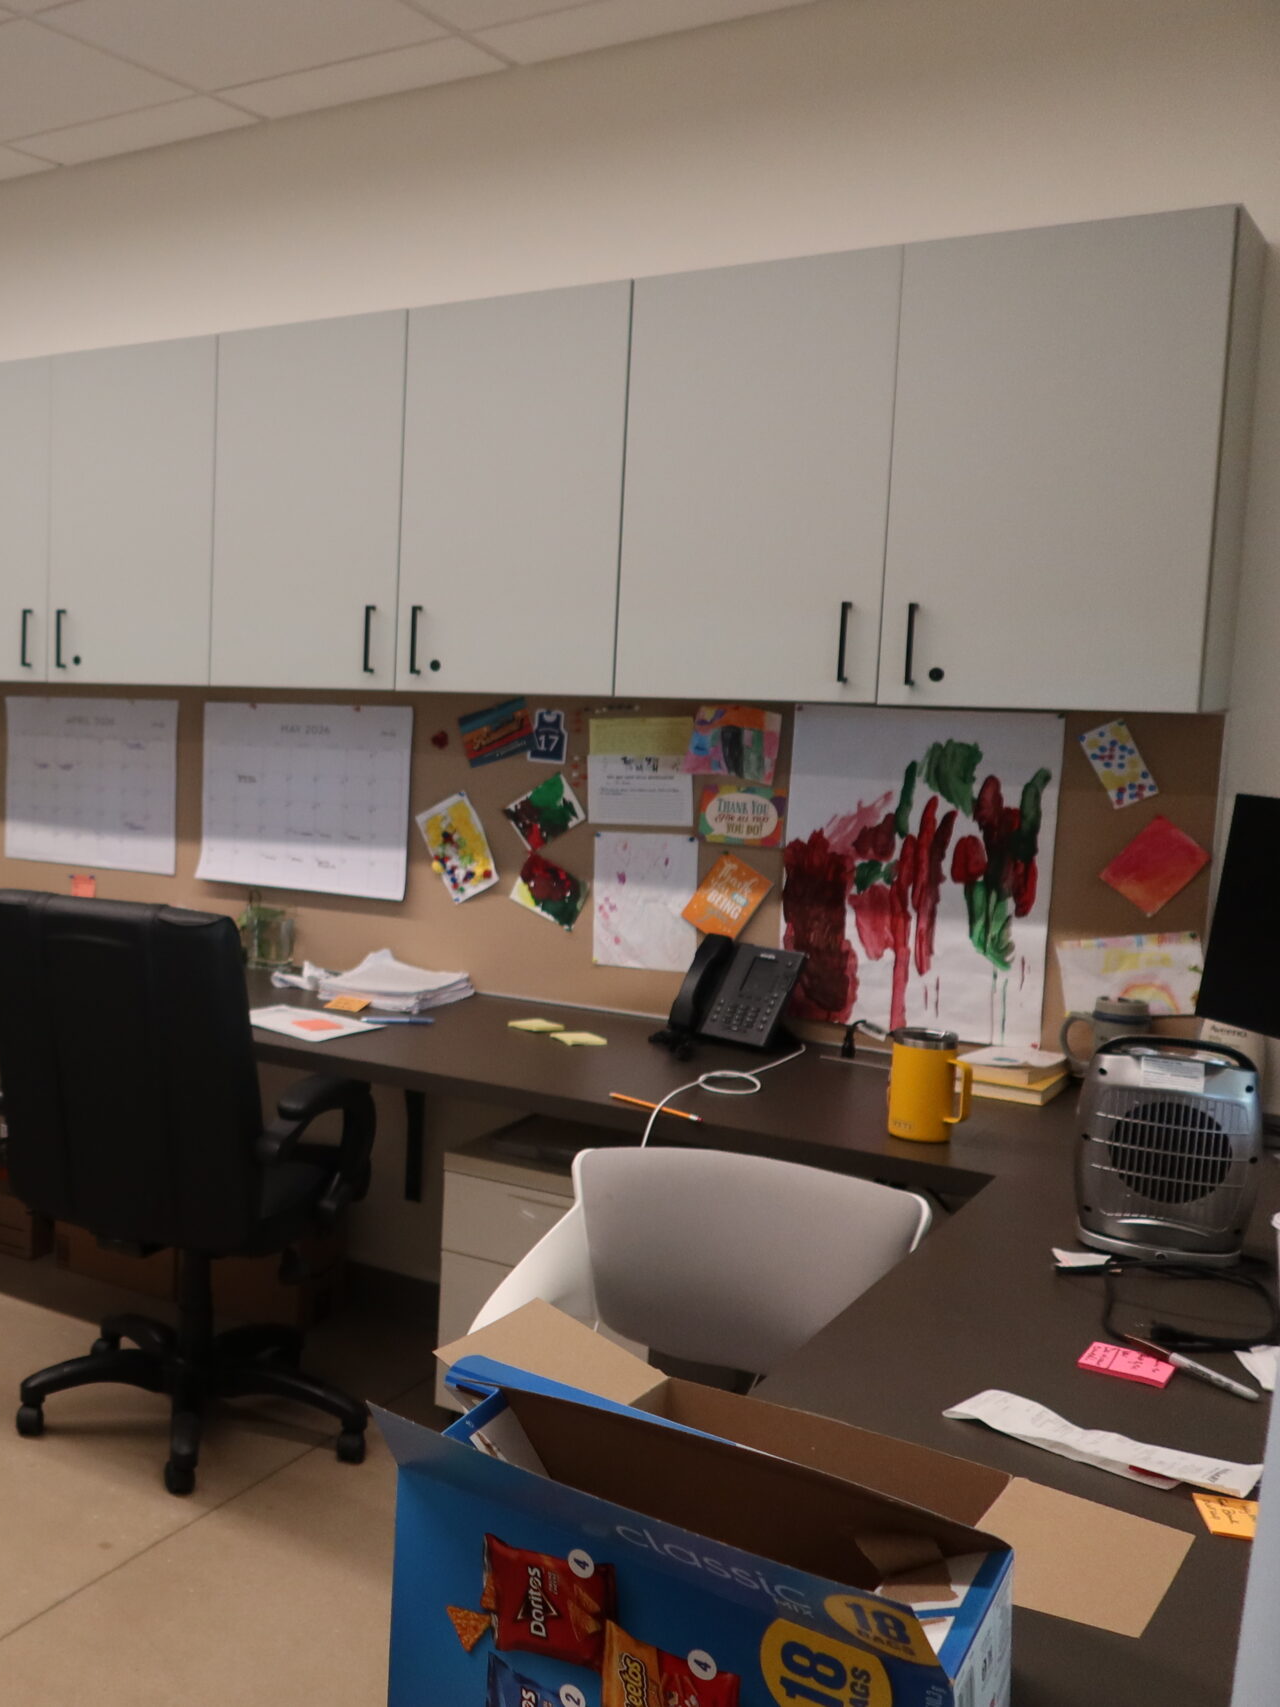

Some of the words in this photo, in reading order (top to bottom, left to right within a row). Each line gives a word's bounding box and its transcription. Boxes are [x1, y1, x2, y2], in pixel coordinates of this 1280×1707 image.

[280, 724, 301, 734] MAY
[305, 725, 331, 735] 2026
[538, 735, 559, 752] 17
[717, 800, 749, 814] THANK
[751, 800, 769, 814] YOU
[726, 823, 745, 834] YOU
[706, 889, 743, 920] BEING
[573, 1557, 589, 1570] 4
[615, 1525, 812, 1610] classic
[527, 1566, 548, 1638] Doritos
[845, 1602, 914, 1646] 18
[693, 1658, 712, 1673] 4
[780, 1641, 848, 1707] 18
[565, 1693, 581, 1707] 2
